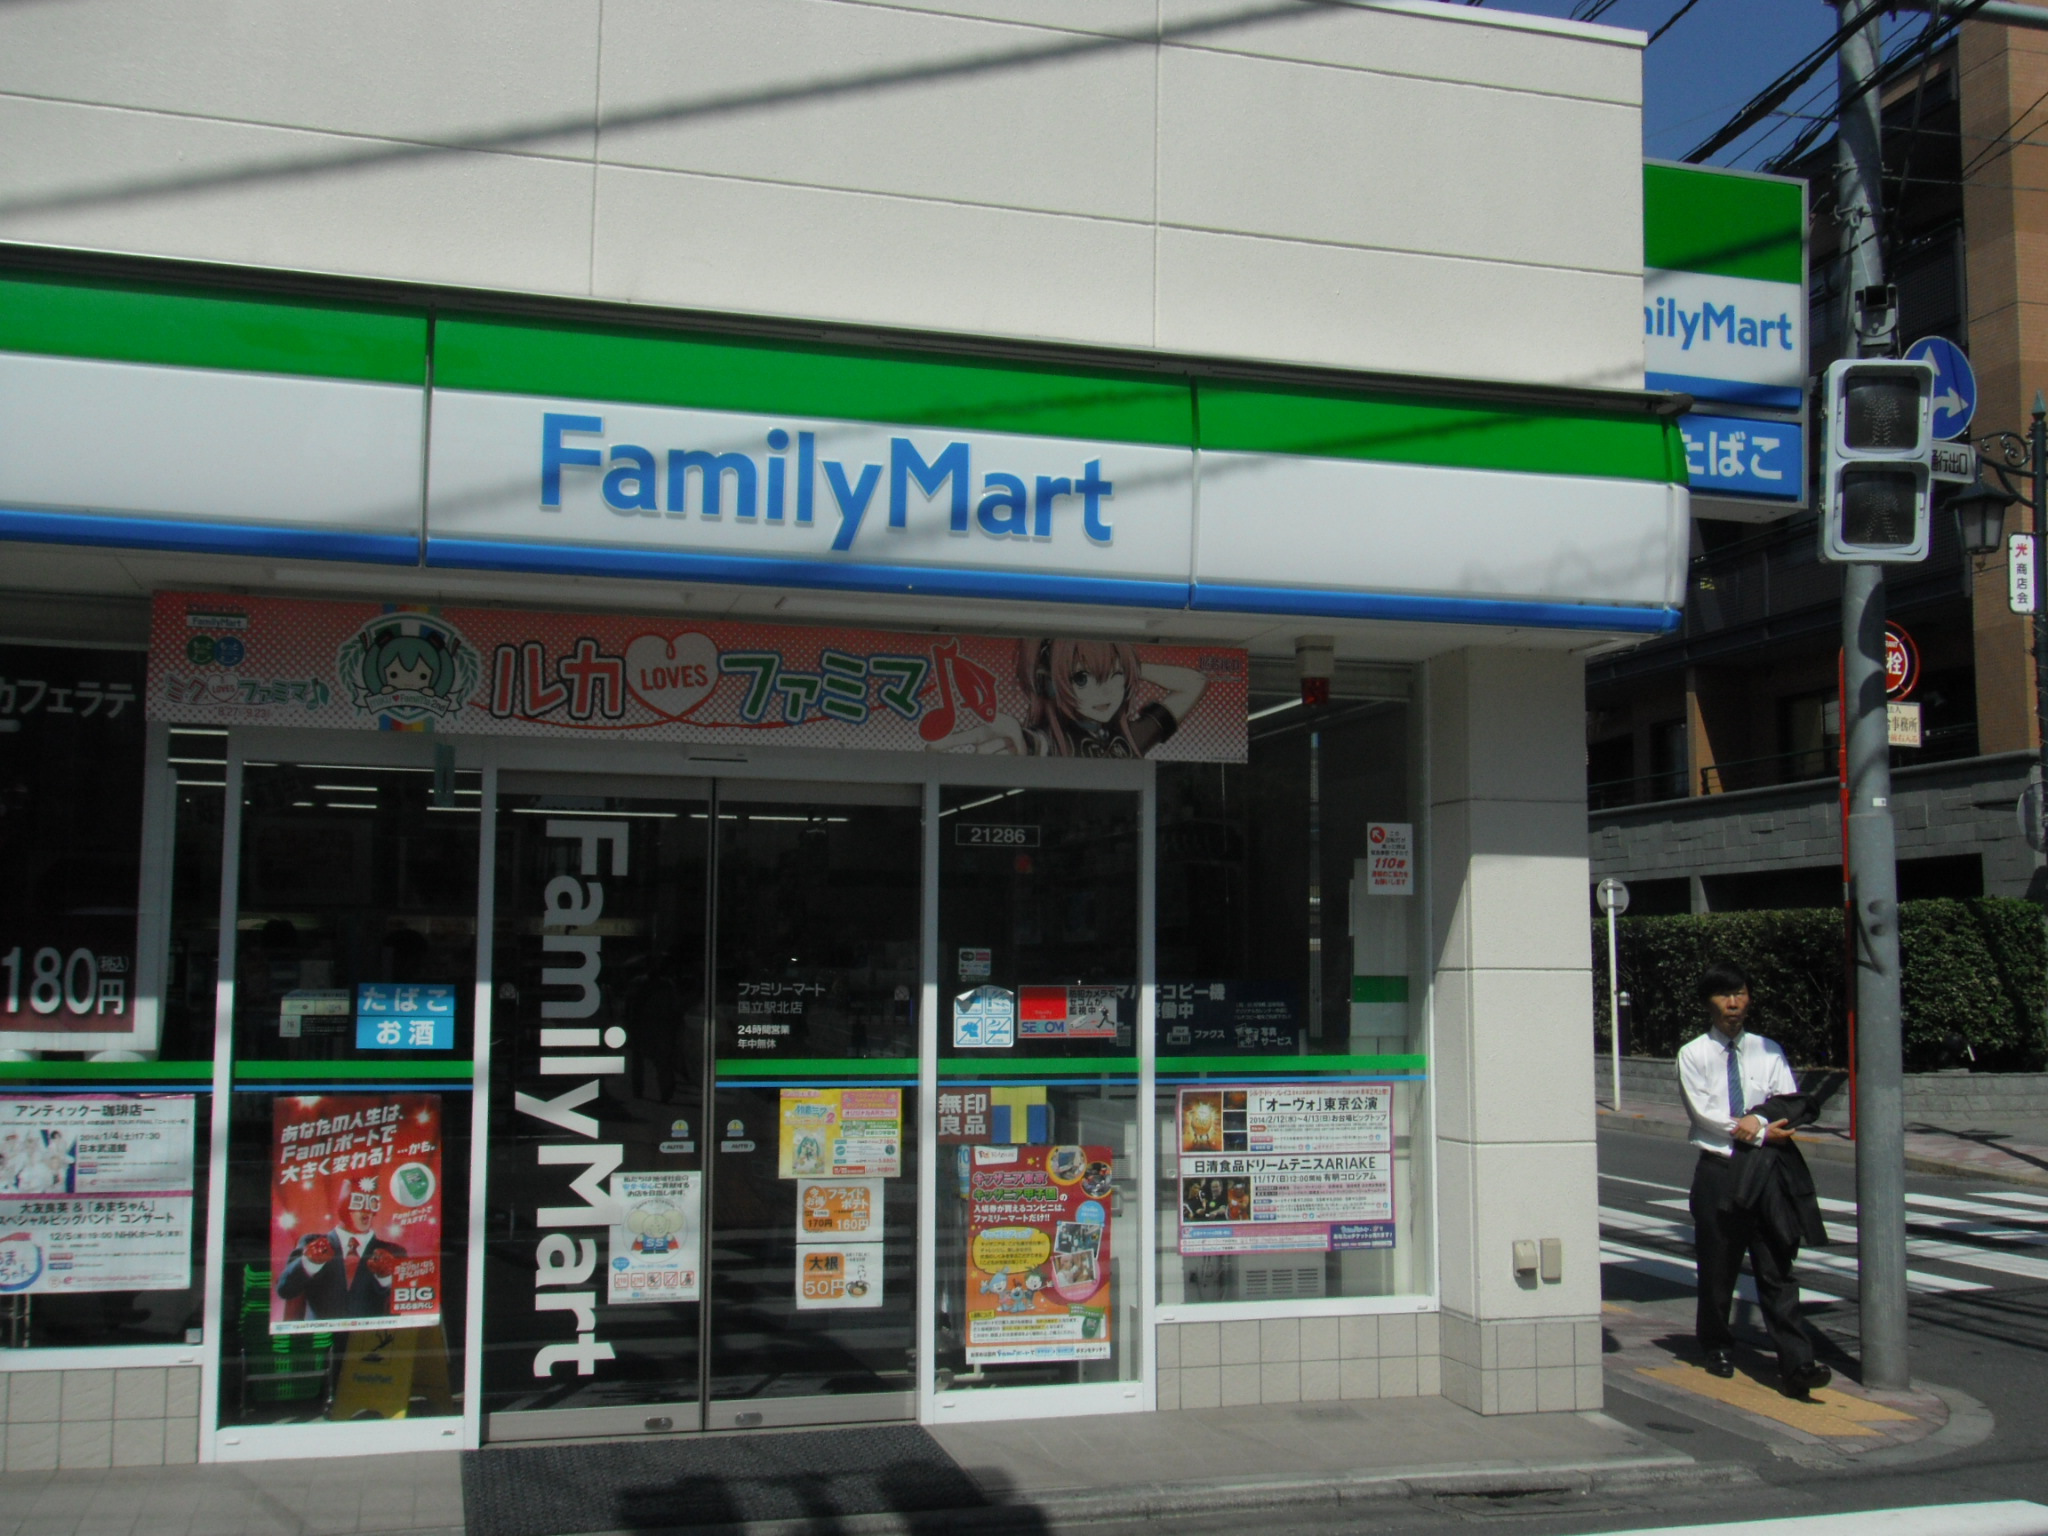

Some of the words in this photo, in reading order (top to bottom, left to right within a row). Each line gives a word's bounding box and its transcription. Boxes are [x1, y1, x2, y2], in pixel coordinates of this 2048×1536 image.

[1680, 428, 1782, 480] たばこ
[539, 411, 1113, 551] FamilyMart
[1886, 651, 1903, 674] 栓
[494, 641, 624, 718] ルカ
[640, 664, 708, 691] LOVES
[719, 650, 929, 722] ファミマ
[1887, 717, 1918, 732] 事務所
[970, 826, 1026, 844] 21286
[738, 982, 826, 997] ファミリーマート
[1069, 989, 1115, 998] 防犯カメラで
[1116, 983, 1226, 1001] マコピー機
[363, 987, 448, 1012] たばこ
[737, 1001, 803, 1014] 国立駅北店
[376, 1020, 436, 1045] お酒
[737, 1025, 790, 1035] 24時間営業
[1022, 1021, 1065, 1032] SECOM
[737, 1039, 777, 1049] 年中無休
[515, 819, 629, 1378] FamilyMart
[1259, 1096, 1378, 1112] 「オーヴォ」東京公演
[281, 1104, 404, 1144] あなたの人生は、
[281, 1124, 397, 1164] Famiポートで
[1194, 1156, 1376, 1173] 日清食品ドリームテニスARIAKE
[348, 1192, 381, 1212] BIG
[828, 1188, 865, 1199] フライド
[841, 1199, 869, 1209] ポテト
[120, 1213, 174, 1224] コンサート
[809, 1255, 839, 1271] 大根
[394, 1287, 434, 1302] BIG
[805, 1279, 845, 1296] 50円
